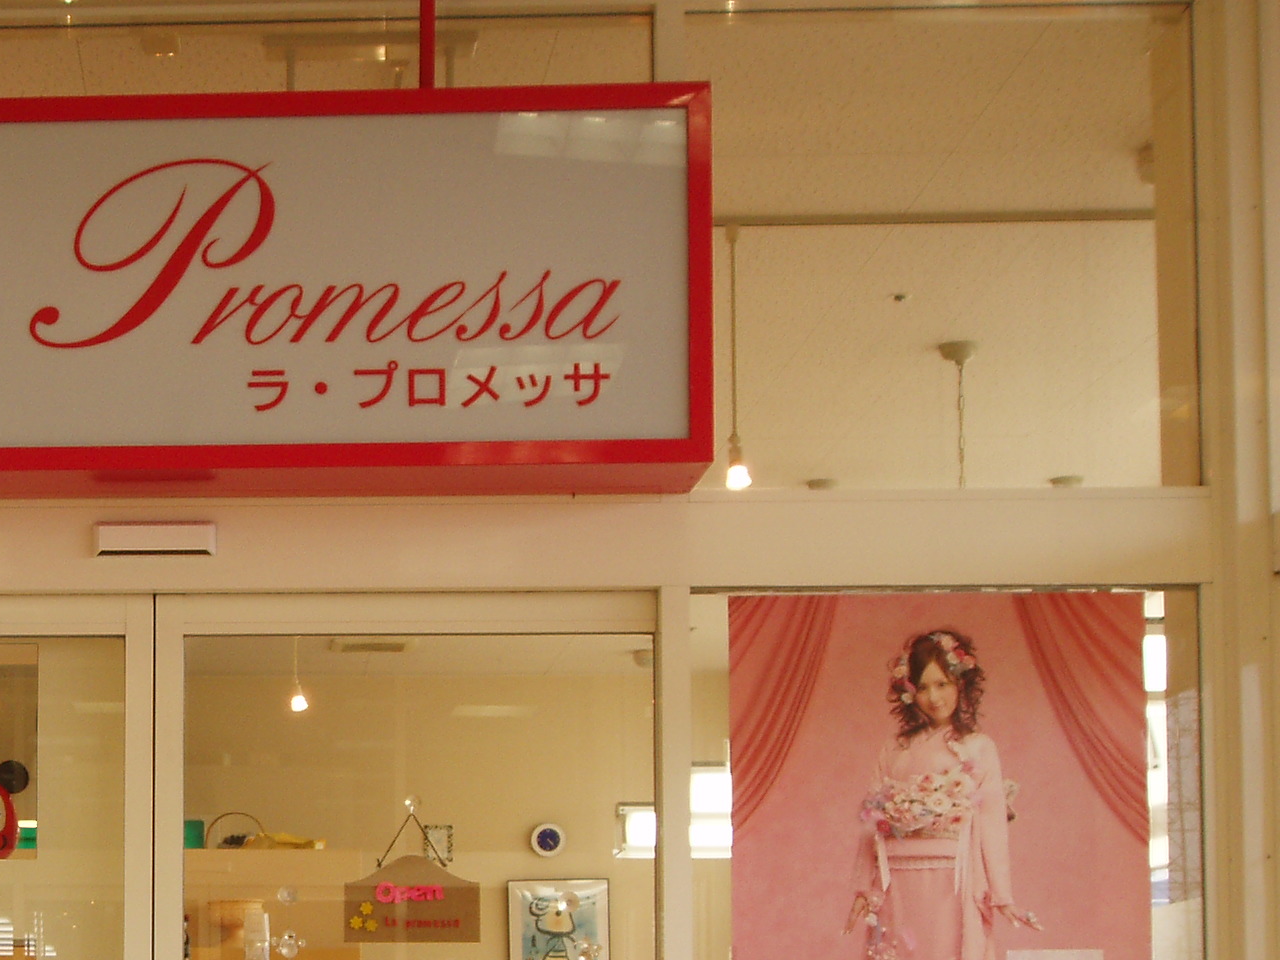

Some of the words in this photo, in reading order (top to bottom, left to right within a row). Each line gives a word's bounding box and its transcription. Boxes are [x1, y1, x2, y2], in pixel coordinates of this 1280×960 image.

[29, 157, 623, 350] Promessa
[247, 361, 612, 412] ラ・プロメッサ
[376, 880, 445, 904] Open
